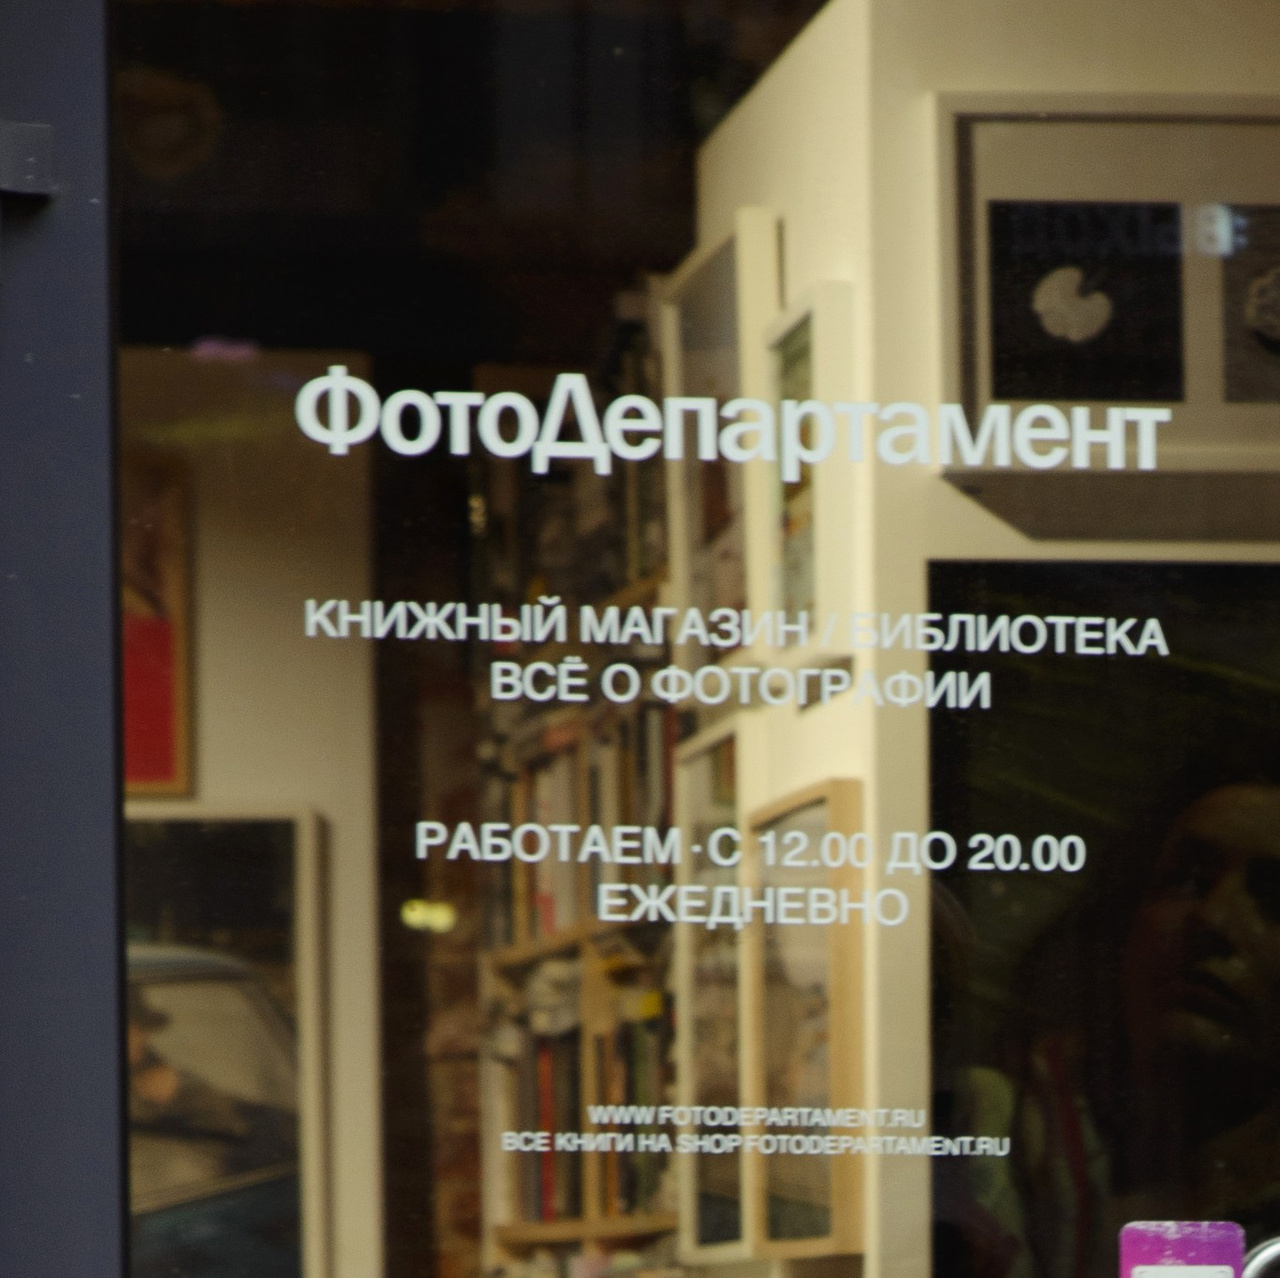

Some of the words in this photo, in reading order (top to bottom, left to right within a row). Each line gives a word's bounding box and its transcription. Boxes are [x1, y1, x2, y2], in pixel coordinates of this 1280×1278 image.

[294, 365, 1172, 483] ФотоДепартамент
[304, 596, 568, 645] КНИЖНЫЙ
[580, 606, 808, 650] МАГАЗИН
[849, 611, 1171, 657] БИБЛИОТЕКА
[489, 656, 588, 703] ВСЁ
[600, 662, 641, 704] О
[651, 662, 992, 710] ФОТОГРАФИИ
[415, 820, 682, 865] РАБОТАЕМ
[759, 828, 871, 869] 12.00
[886, 831, 957, 874] ДО
[967, 833, 1087, 873] 20.00
[597, 883, 909, 930] ЕЖЕДНЕВНО
[500, 1131, 552, 1152] ВСЕ
[554, 1132, 635, 1153] КНИГИ
[637, 1132, 673, 1153] НА
